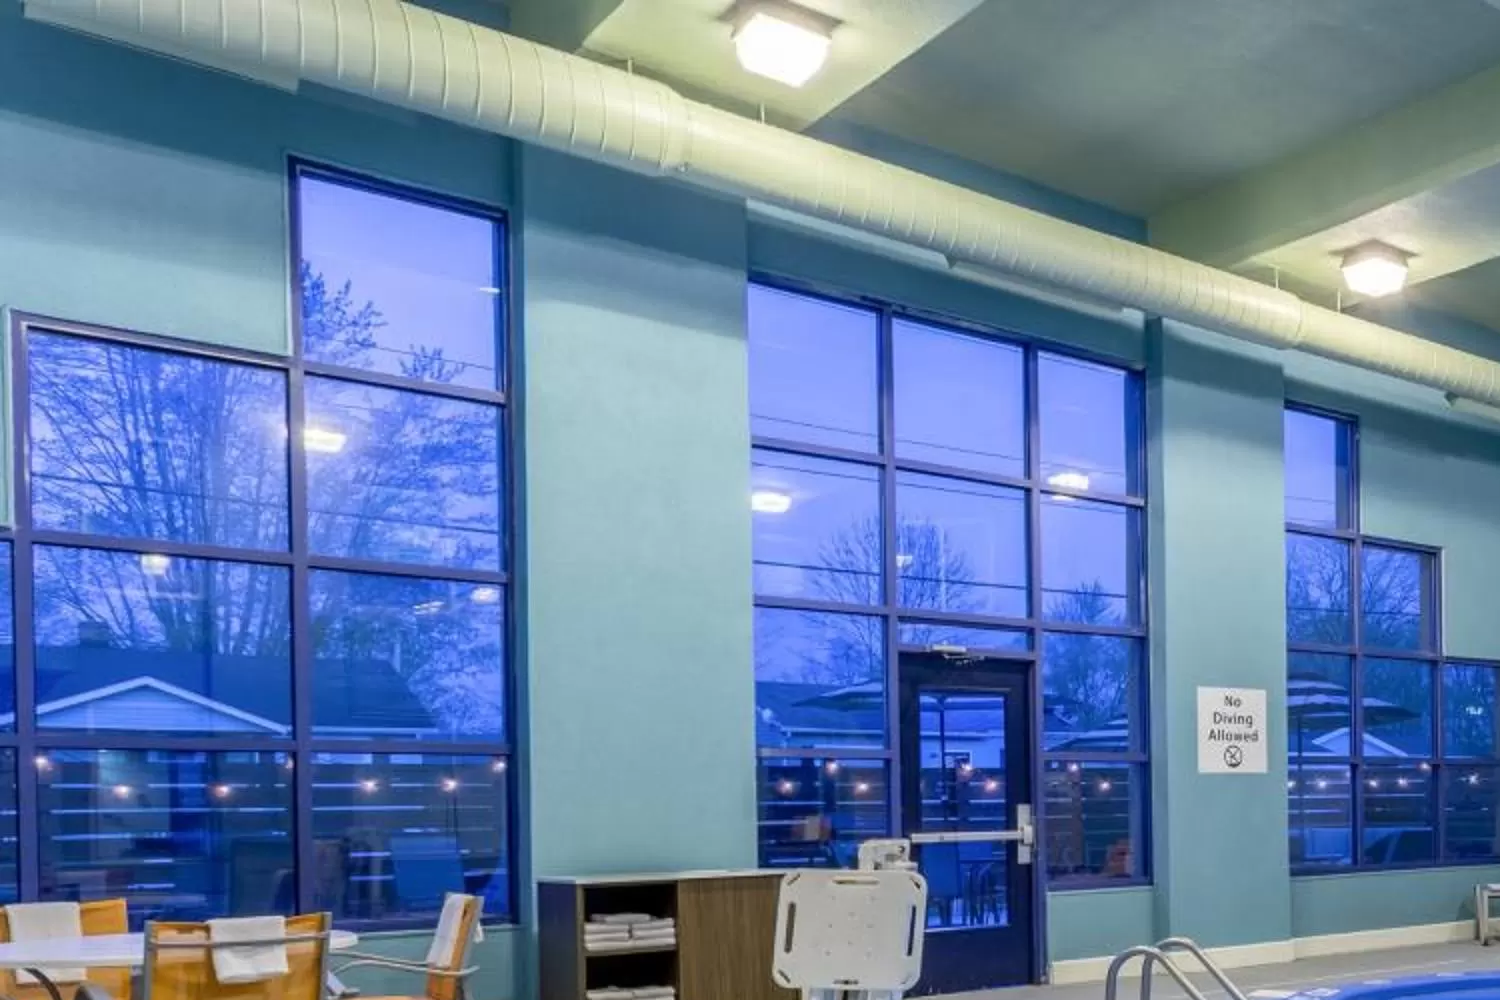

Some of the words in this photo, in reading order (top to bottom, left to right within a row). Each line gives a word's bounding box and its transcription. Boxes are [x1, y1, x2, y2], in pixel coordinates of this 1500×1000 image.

[1224, 695, 1242, 707] No
[1213, 711, 1254, 728] Diving
[1208, 729, 1259, 742] Allowed
